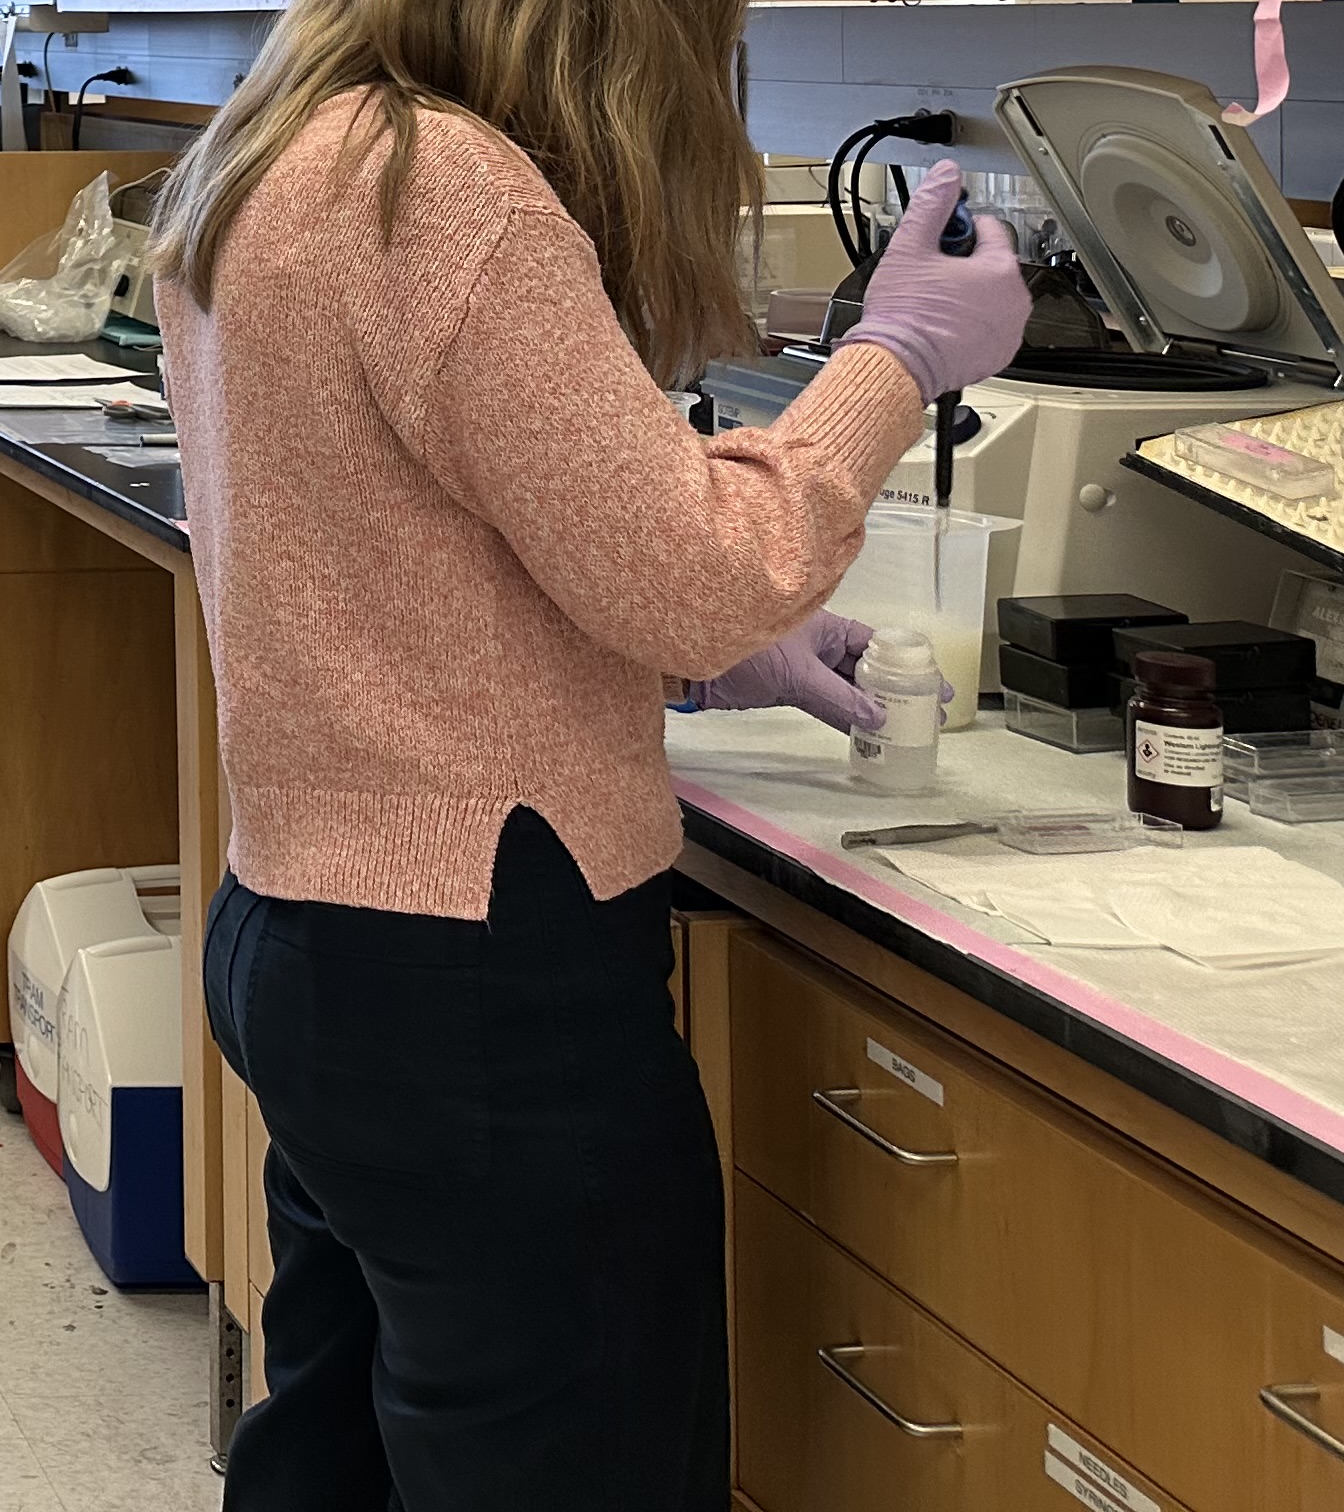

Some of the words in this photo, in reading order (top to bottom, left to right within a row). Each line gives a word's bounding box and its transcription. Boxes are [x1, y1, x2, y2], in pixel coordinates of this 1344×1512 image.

[896, 490, 919, 504] 5415
[921, 495, 930, 506] R
[891, 1057, 916, 1083] BAGS
[1078, 1450, 1129, 1501] NEEDLES
